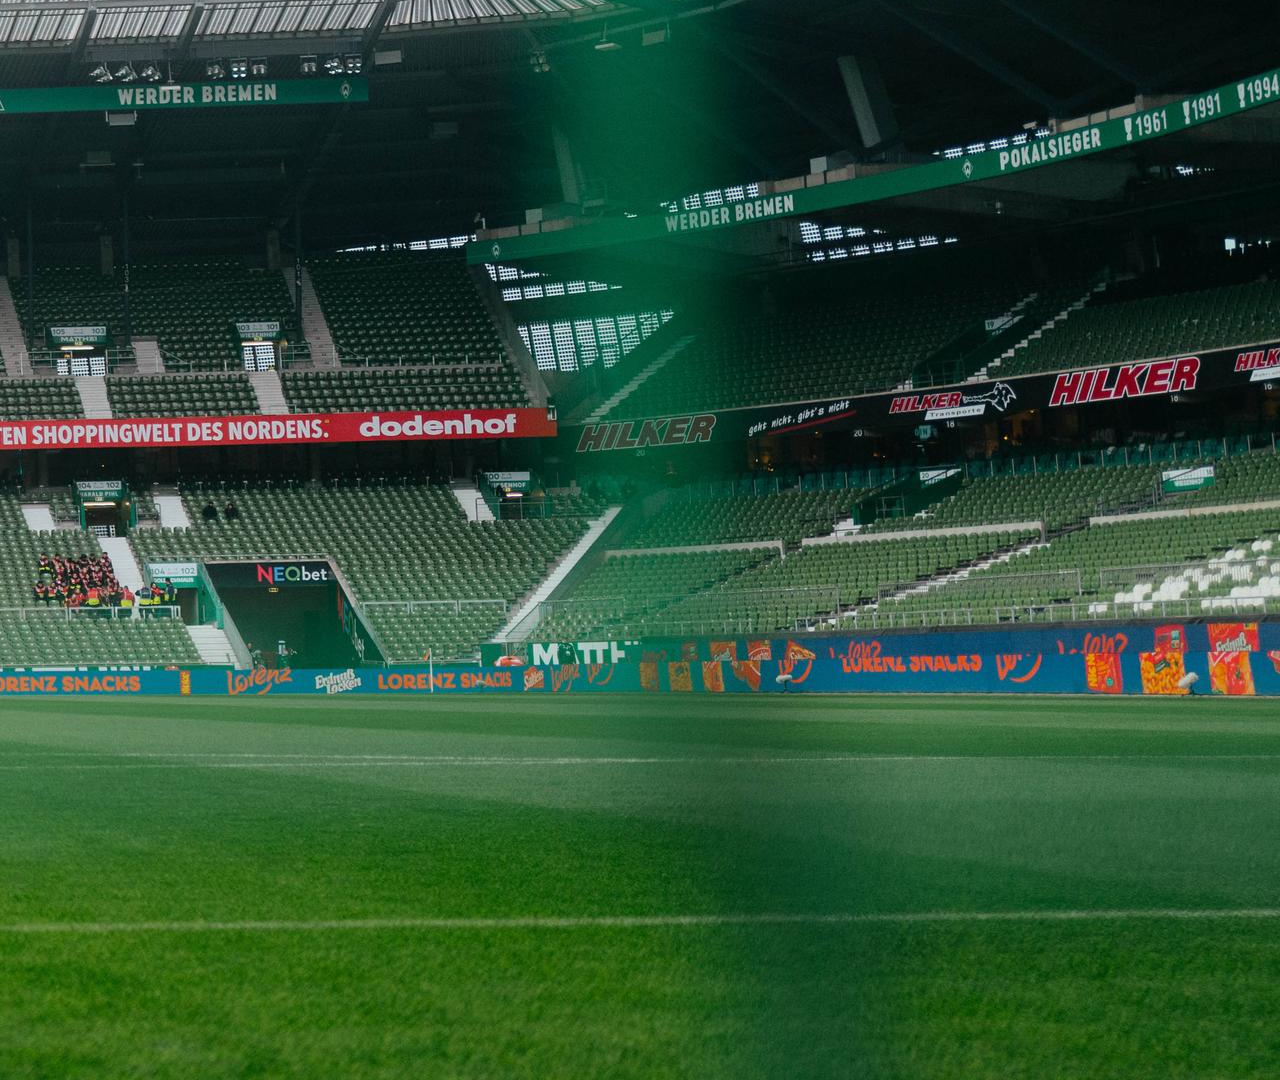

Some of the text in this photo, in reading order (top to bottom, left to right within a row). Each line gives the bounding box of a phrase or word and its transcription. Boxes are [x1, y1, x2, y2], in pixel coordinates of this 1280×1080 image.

[118, 83, 277, 106] WERDER BREMEN
[999, 73, 1280, 170] POKALSIEGER 1961 1991 1994
[664, 194, 794, 233] WERDER BREMEN
[1049, 357, 1201, 407] HILKER
[888, 392, 961, 414] HILKER
[32, 422, 184, 444] SHOPPINGWELT
[187, 421, 224, 442] DES
[228, 419, 329, 440] NORDENS.
[359, 414, 517, 438] dodenhof
[748, 421, 767, 437] geht
[828, 400, 851, 414] nicht
[576, 414, 716, 452] HILKER
[62, 675, 140, 692] SNACKS
[226, 667, 293, 696] Lorenz
[378, 673, 456, 690] LORENZ
